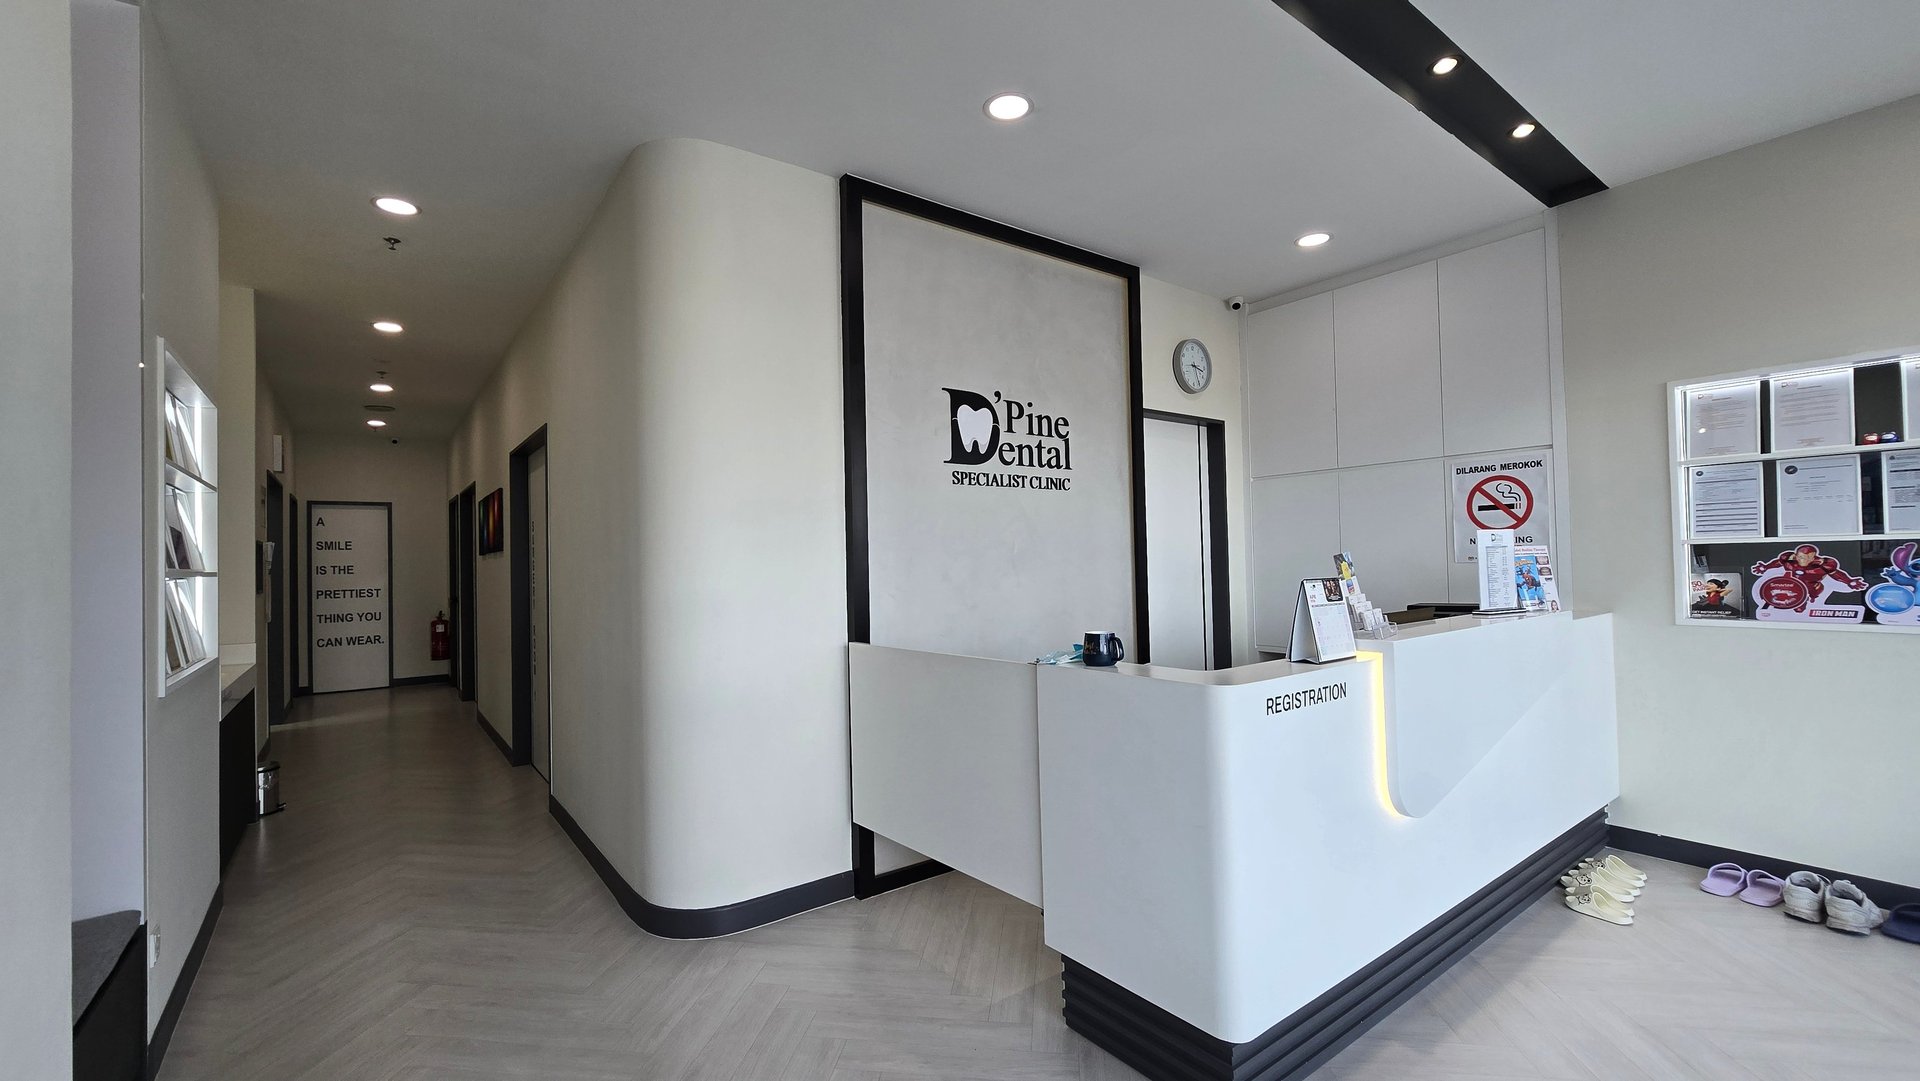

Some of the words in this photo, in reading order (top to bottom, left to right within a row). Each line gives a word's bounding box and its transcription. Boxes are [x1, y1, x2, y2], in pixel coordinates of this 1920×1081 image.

[1456, 464, 1497, 475] DILARANG
[1500, 459, 1543, 471] MEROKOK
[952, 470, 1028, 488] SPECIALIST
[1029, 476, 1071, 491] CLINIC
[316, 517, 325, 527] A
[316, 541, 352, 551] SMILE
[316, 565, 327, 575] IS
[331, 565, 354, 575] THE
[316, 588, 381, 600] PRETTIEST
[316, 613, 353, 624] THING
[357, 612, 381, 622] YOU
[316, 637, 342, 648] CAN
[346, 635, 385, 646] WEAR.
[1266, 682, 1347, 716] REGISTRATION
